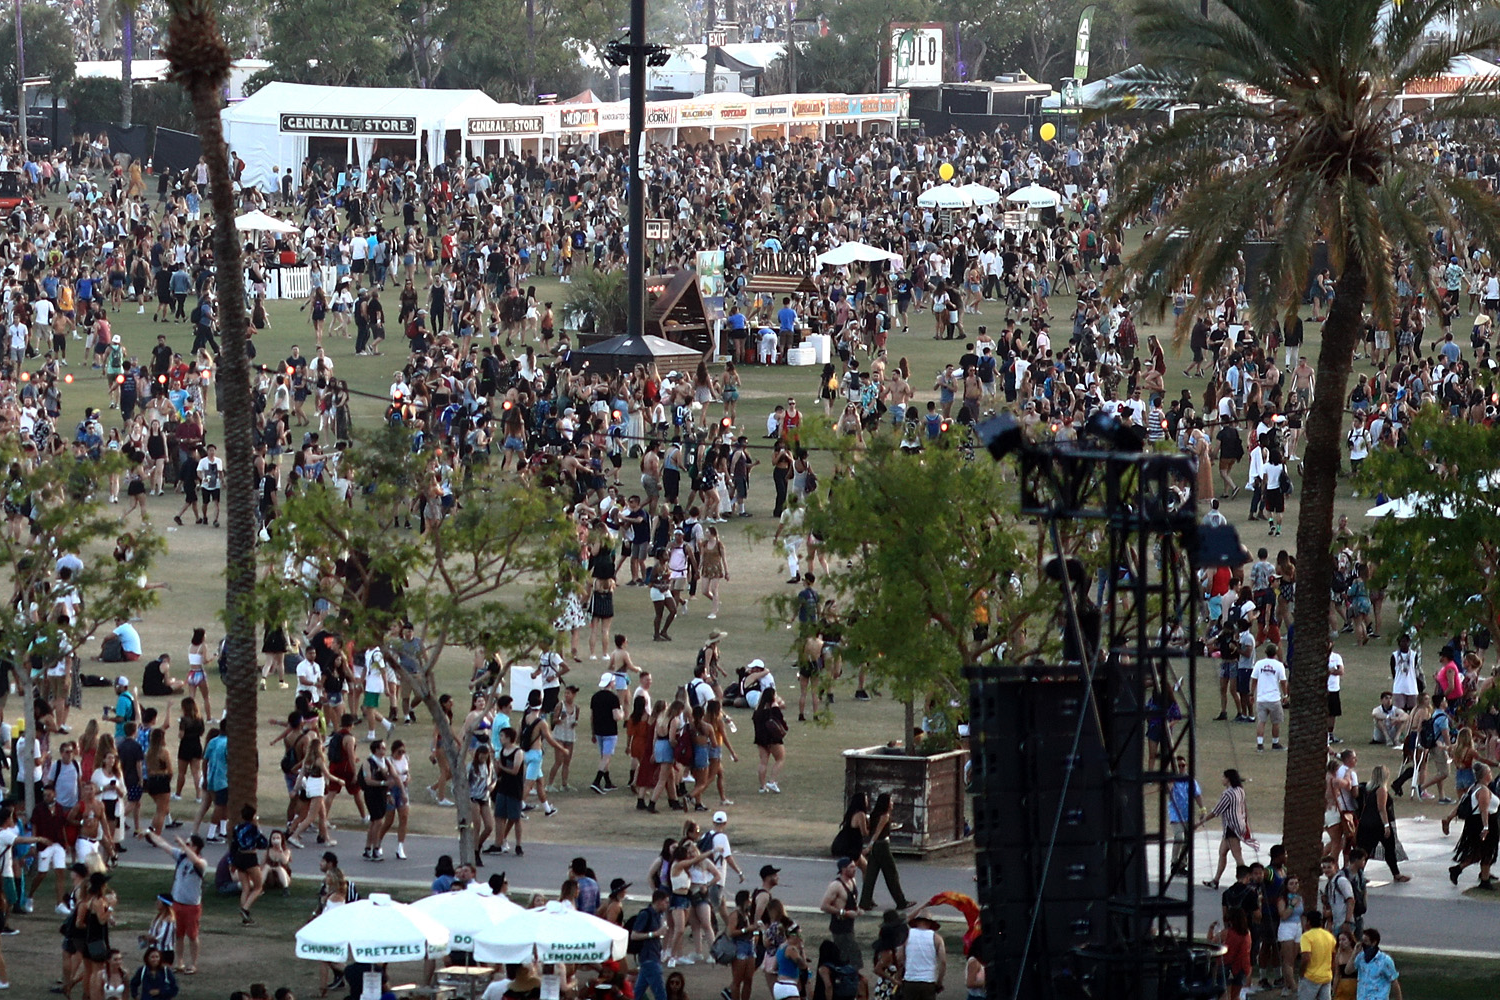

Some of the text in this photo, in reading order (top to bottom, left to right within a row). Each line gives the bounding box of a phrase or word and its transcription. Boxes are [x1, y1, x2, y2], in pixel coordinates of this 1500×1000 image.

[708, 32, 727, 47] EXIT
[1074, 18, 1090, 67] ATM
[899, 39, 910, 80] ATM
[1066, 81, 1075, 106] ATM
[287, 117, 408, 131] GENERAL STORE
[647, 112, 669, 123] CORN
[471, 119, 540, 132] GENERAL STORE
[300, 943, 345, 956] CHURROS
[356, 944, 421, 957] PRETZELS
[551, 941, 596, 951] FROZEN
[543, 952, 605, 962] LEMONADE
